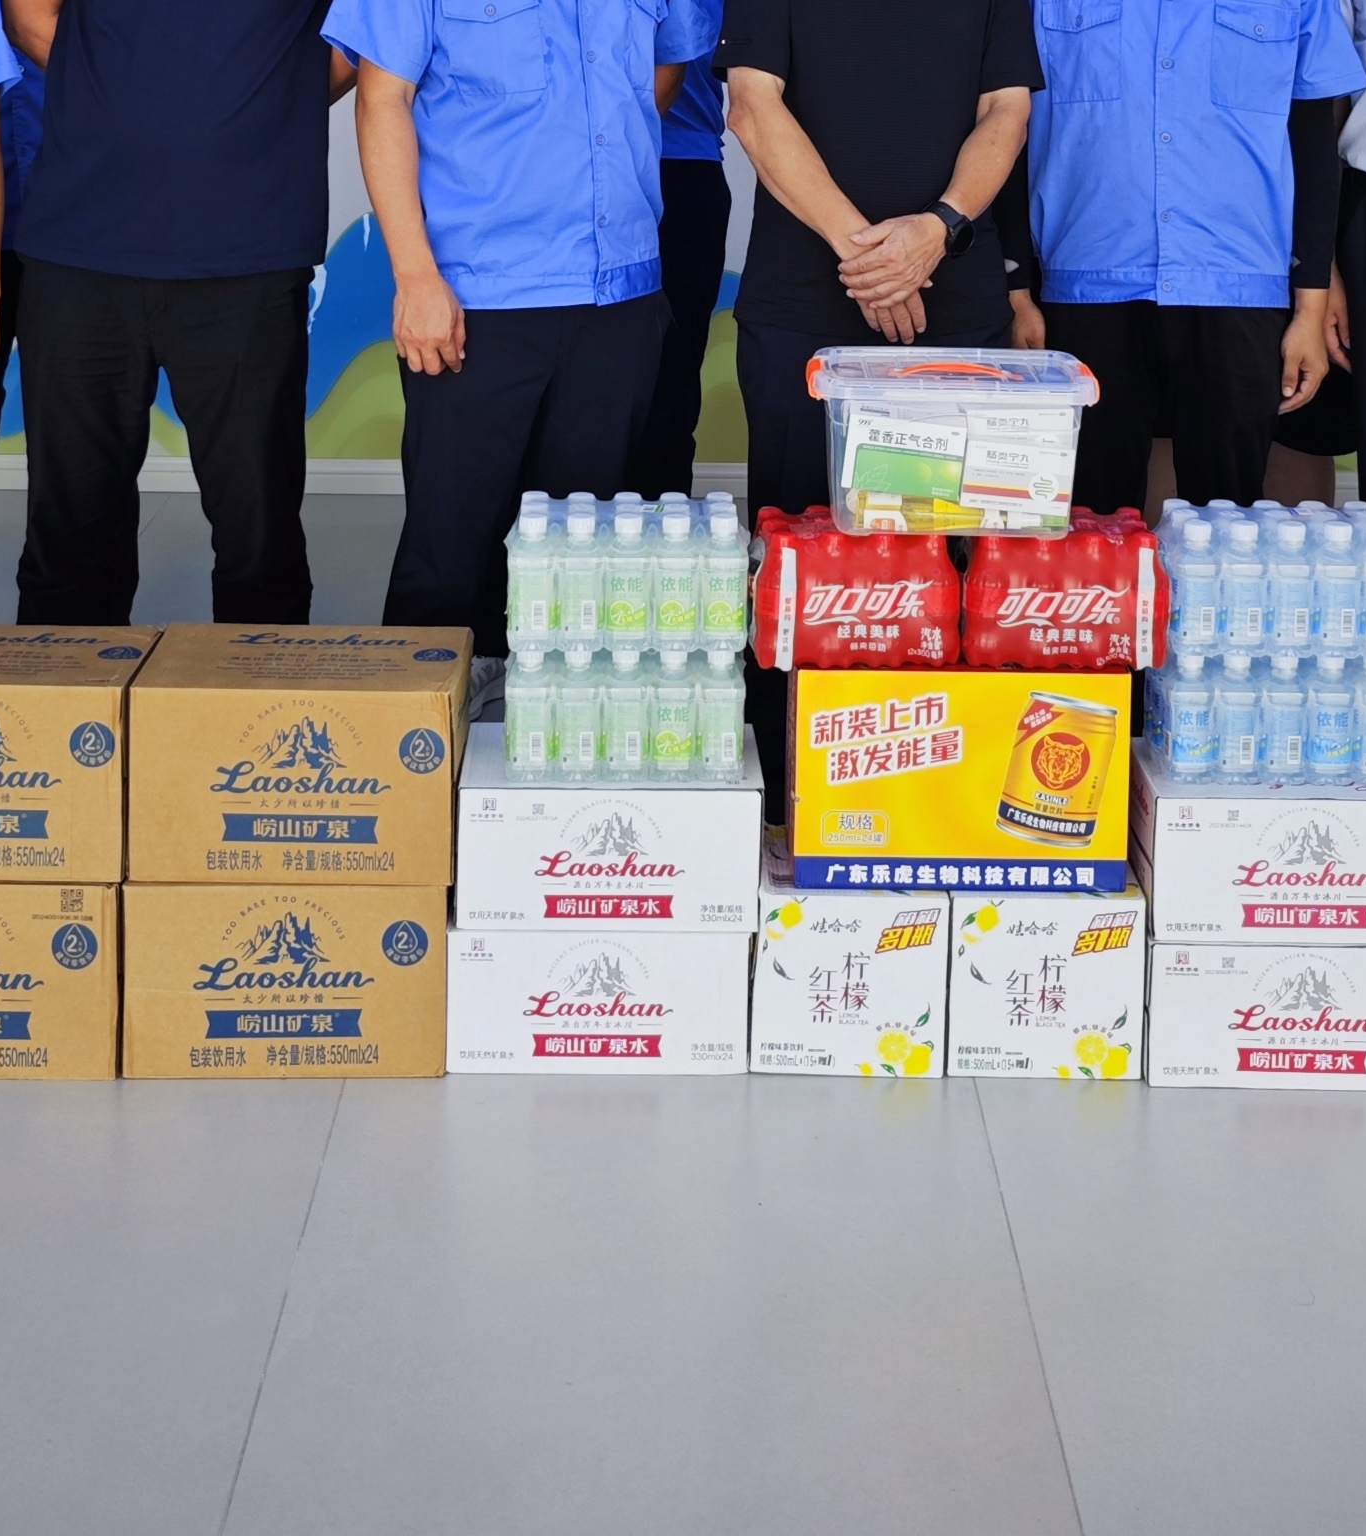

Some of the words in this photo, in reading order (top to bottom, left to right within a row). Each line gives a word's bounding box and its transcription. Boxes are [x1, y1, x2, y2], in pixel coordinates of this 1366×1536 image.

[610, 577, 642, 592] 依能
[661, 577, 693, 592] 依能
[709, 577, 741, 592] 依能
[803, 580, 934, 626] 可口可乐
[997, 585, 1130, 627] 可口可乐
[229, 633, 419, 647] Laoshan
[837, 625, 900, 639] 经典美味
[921, 626, 942, 641] 汽水
[1030, 628, 1093, 643] 经典美味
[1110, 634, 1130, 647] 汽水
[239, 723, 254, 745] TOO
[257, 703, 284, 721] RARE
[292, 699, 315, 707] TOO
[322, 704, 365, 747] PRECIOUS
[657, 707, 689, 723] 依能
[813, 694, 947, 746] 新装上市
[1177, 710, 1210, 726] 依能
[1316, 711, 1349, 728] 依能
[829, 729, 962, 783] 激发能量
[210, 761, 391, 794] Laoshan
[1035, 792, 1069, 806] KASINLE
[253, 818, 350, 839] 崂山矿泉
[838, 815, 873, 830] 规格
[206, 849, 262, 870] 包装饮用水
[535, 850, 685, 878] Laoshan
[826, 864, 1095, 887] 广东乐虎生物科技有限公司
[469, 911, 525, 920] 饮用天然矿泉水
[557, 898, 661, 916] 崂山矿泉水
[222, 921, 237, 941] TOO
[240, 899, 266, 917] RARE
[305, 900, 346, 940] PRECIOUS
[810, 917, 862, 933] 娃哈哈
[1255, 908, 1359, 926] 崂山矿泉水
[1007, 920, 1058, 936] 娃哈哈
[1166, 922, 1223, 932] 饮用天然矿泉水
[193, 957, 375, 990] Laoshan
[840, 951, 871, 1012] 柠檬
[1036, 954, 1067, 1014] 柠檬
[808, 966, 838, 1024] 红茶
[1005, 969, 1035, 1027] 红茶
[523, 990, 673, 1018] Laoshan
[237, 1014, 334, 1033] 崂山矿泉
[545, 1037, 649, 1054] 崂山矿泉水
[760, 1042, 804, 1052] 柠檬味茶饮料
[958, 1046, 1001, 1055] 柠檬味茶饮料
[190, 1046, 246, 1067] 包装饮用水
[459, 1050, 515, 1060] 饮用天然矿泉水
[1249, 1052, 1355, 1070] 崂山矿泉水
[1163, 1066, 1219, 1076] 饮用天然矿泉水
